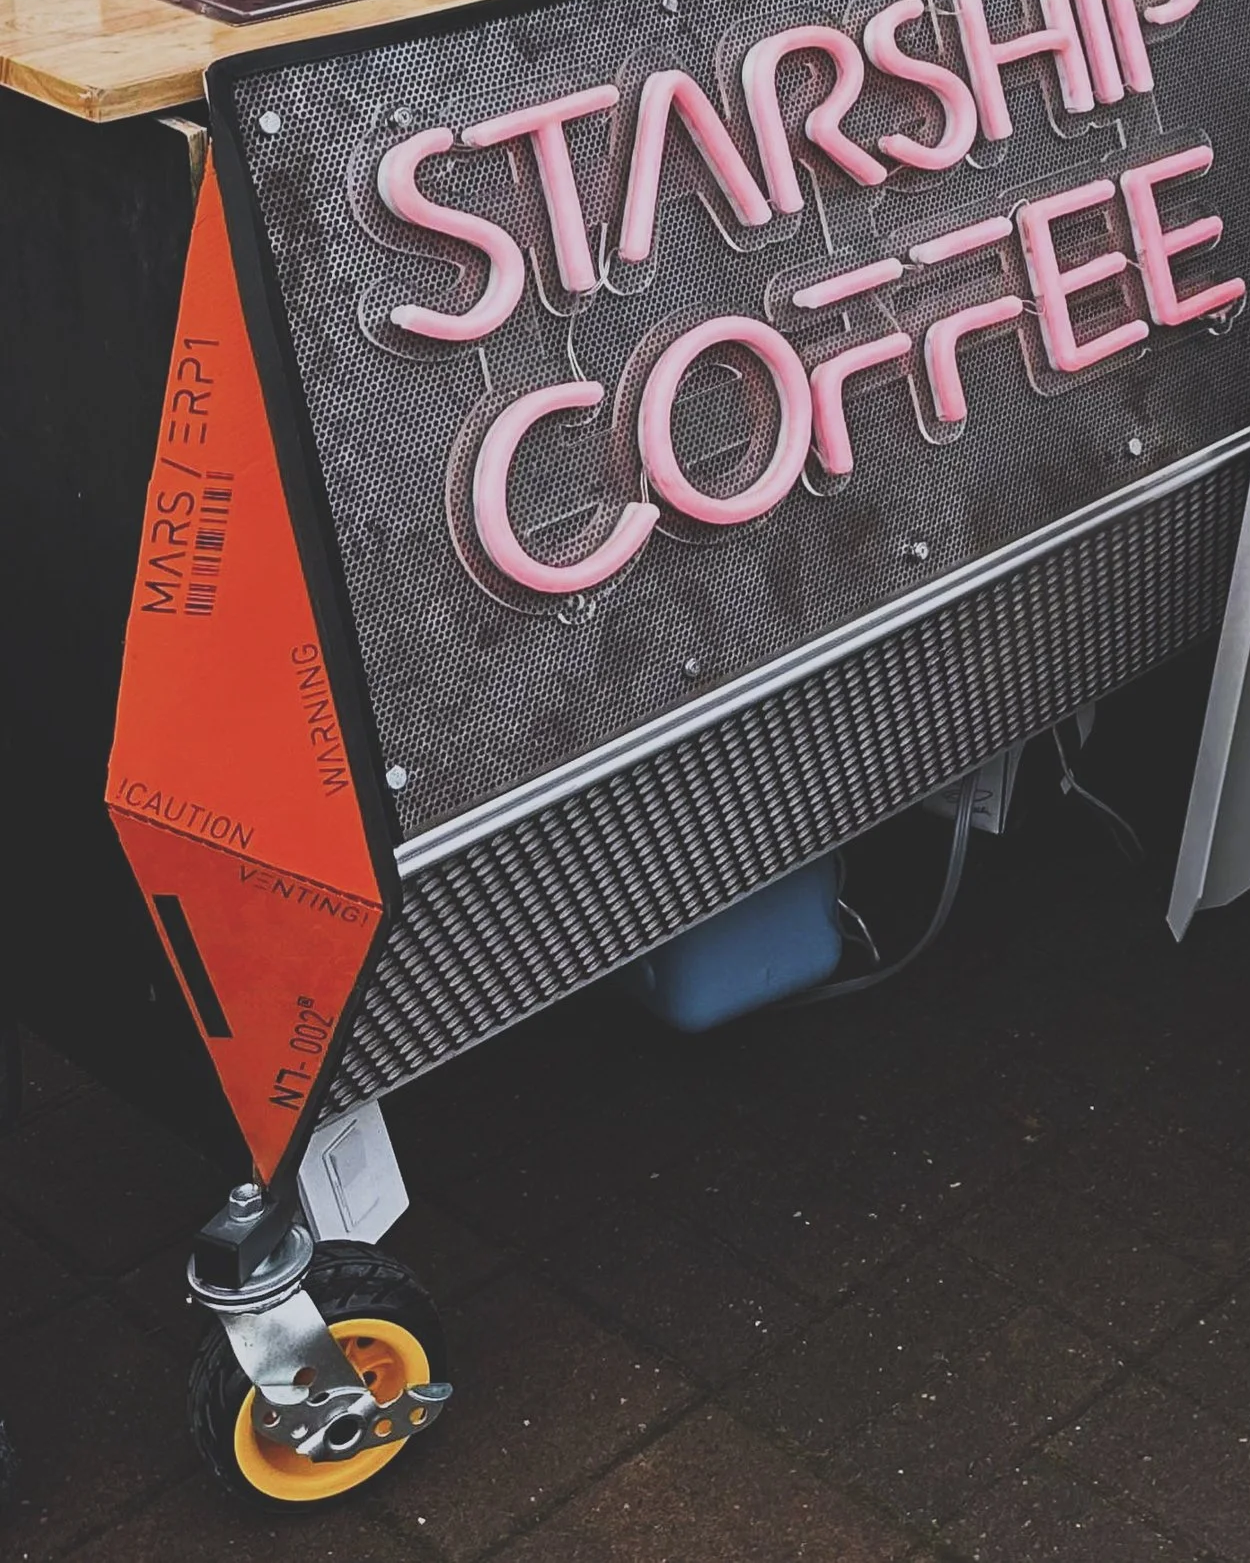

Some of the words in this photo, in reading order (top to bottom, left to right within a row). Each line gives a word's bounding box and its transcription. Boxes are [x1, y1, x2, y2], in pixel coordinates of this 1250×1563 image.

[472, 144, 1246, 593] COFFEE
[141, 491, 195, 614] MARS
[291, 642, 350, 796] WARNING
[239, 864, 370, 928] VENTING!
